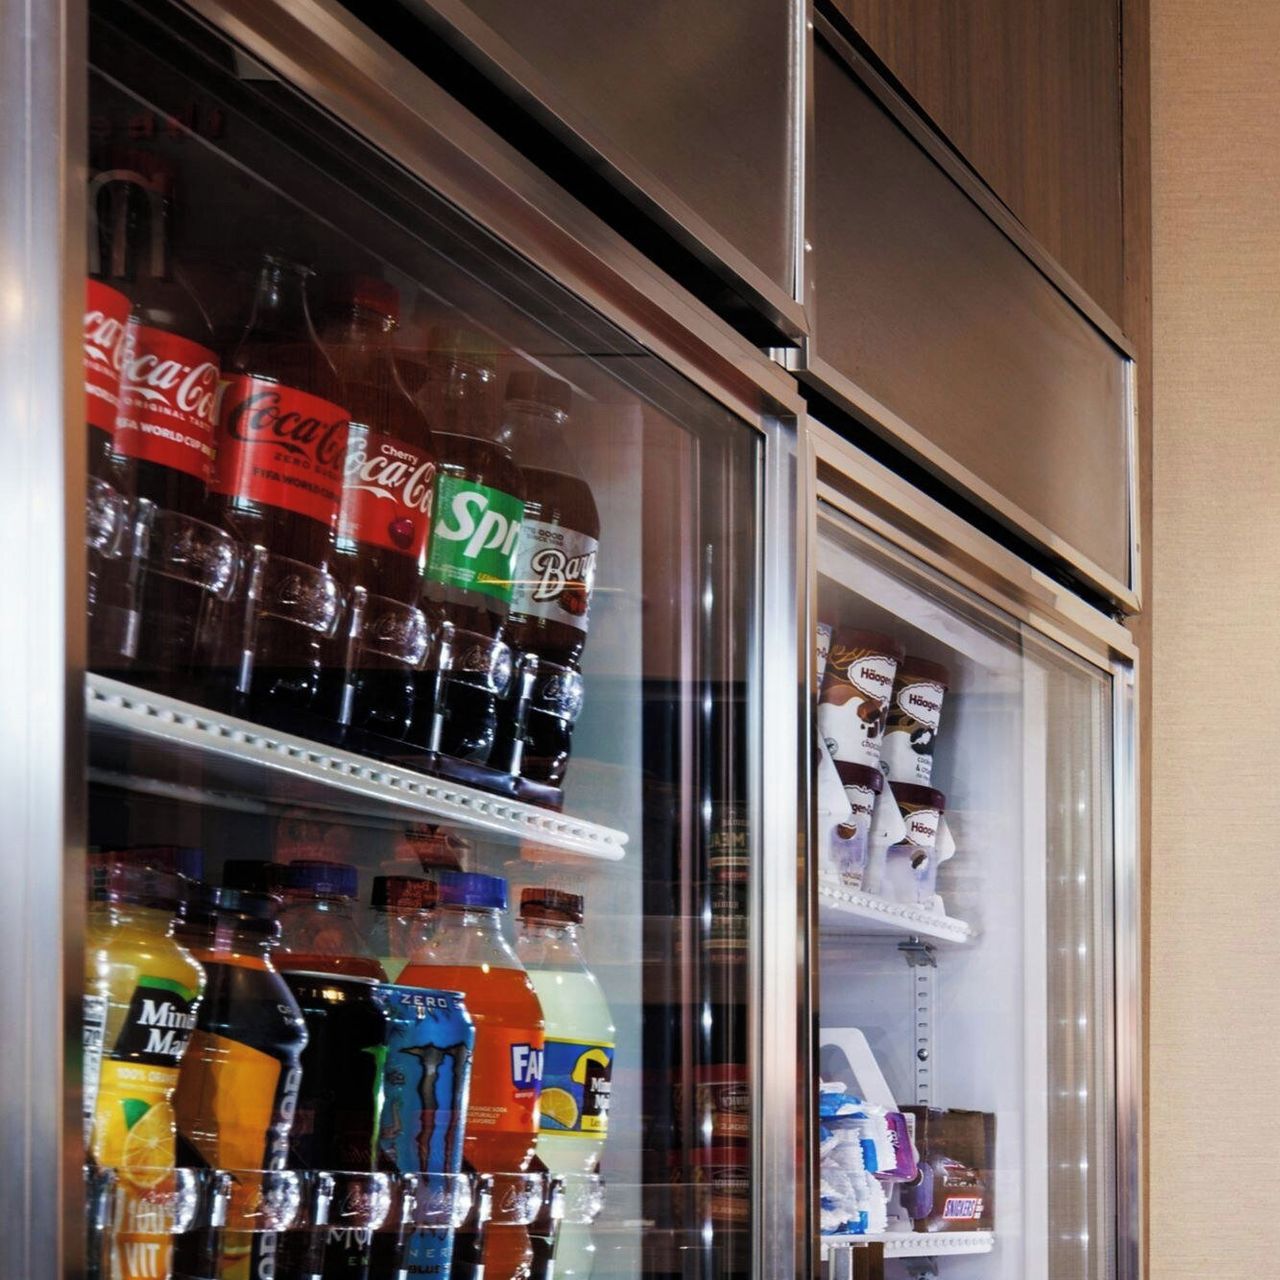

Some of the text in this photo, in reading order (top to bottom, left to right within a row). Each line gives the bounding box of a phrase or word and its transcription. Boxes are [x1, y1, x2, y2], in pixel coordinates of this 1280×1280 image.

[380, 444, 418, 464] Cherry
[434, 490, 521, 558] Spr
[401, 992, 448, 1009] ZERO
